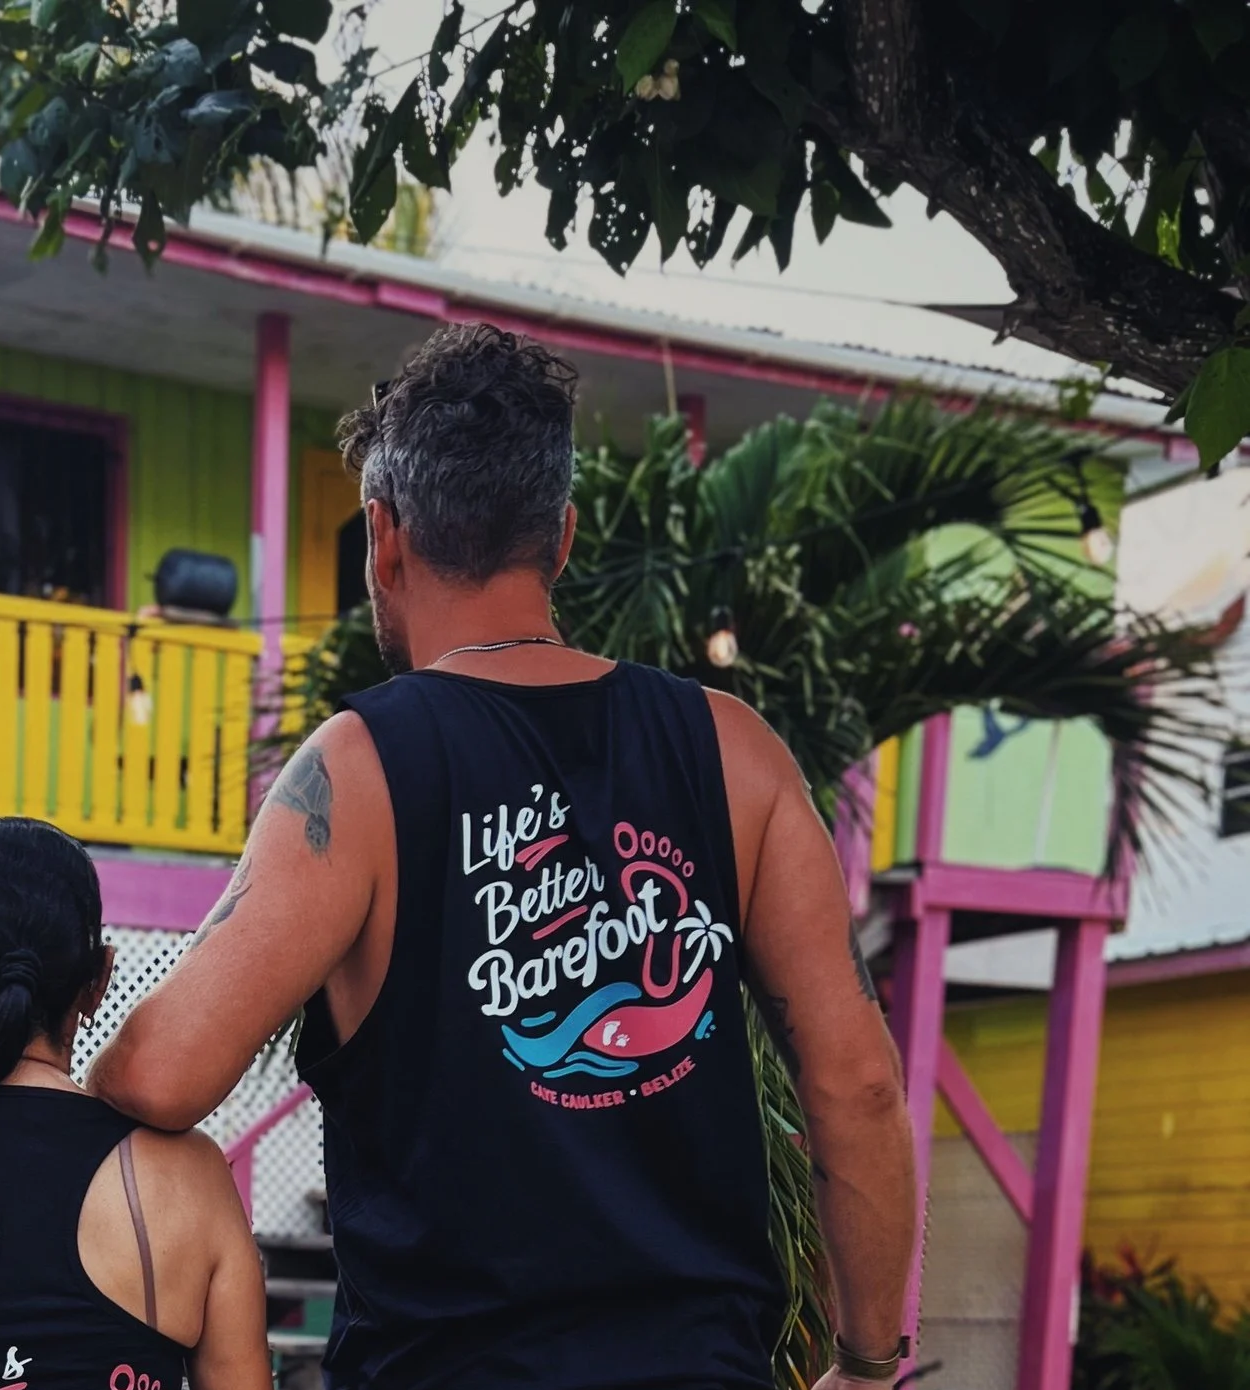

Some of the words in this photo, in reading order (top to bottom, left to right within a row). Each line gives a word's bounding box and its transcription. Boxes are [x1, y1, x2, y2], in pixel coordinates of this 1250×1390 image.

[461, 783, 571, 876] Life's
[474, 855, 605, 946] Better
[468, 878, 668, 1017] Barefoot
[560, 1090, 626, 1110] CAULKER
[640, 1055, 697, 1097] BELIZE
